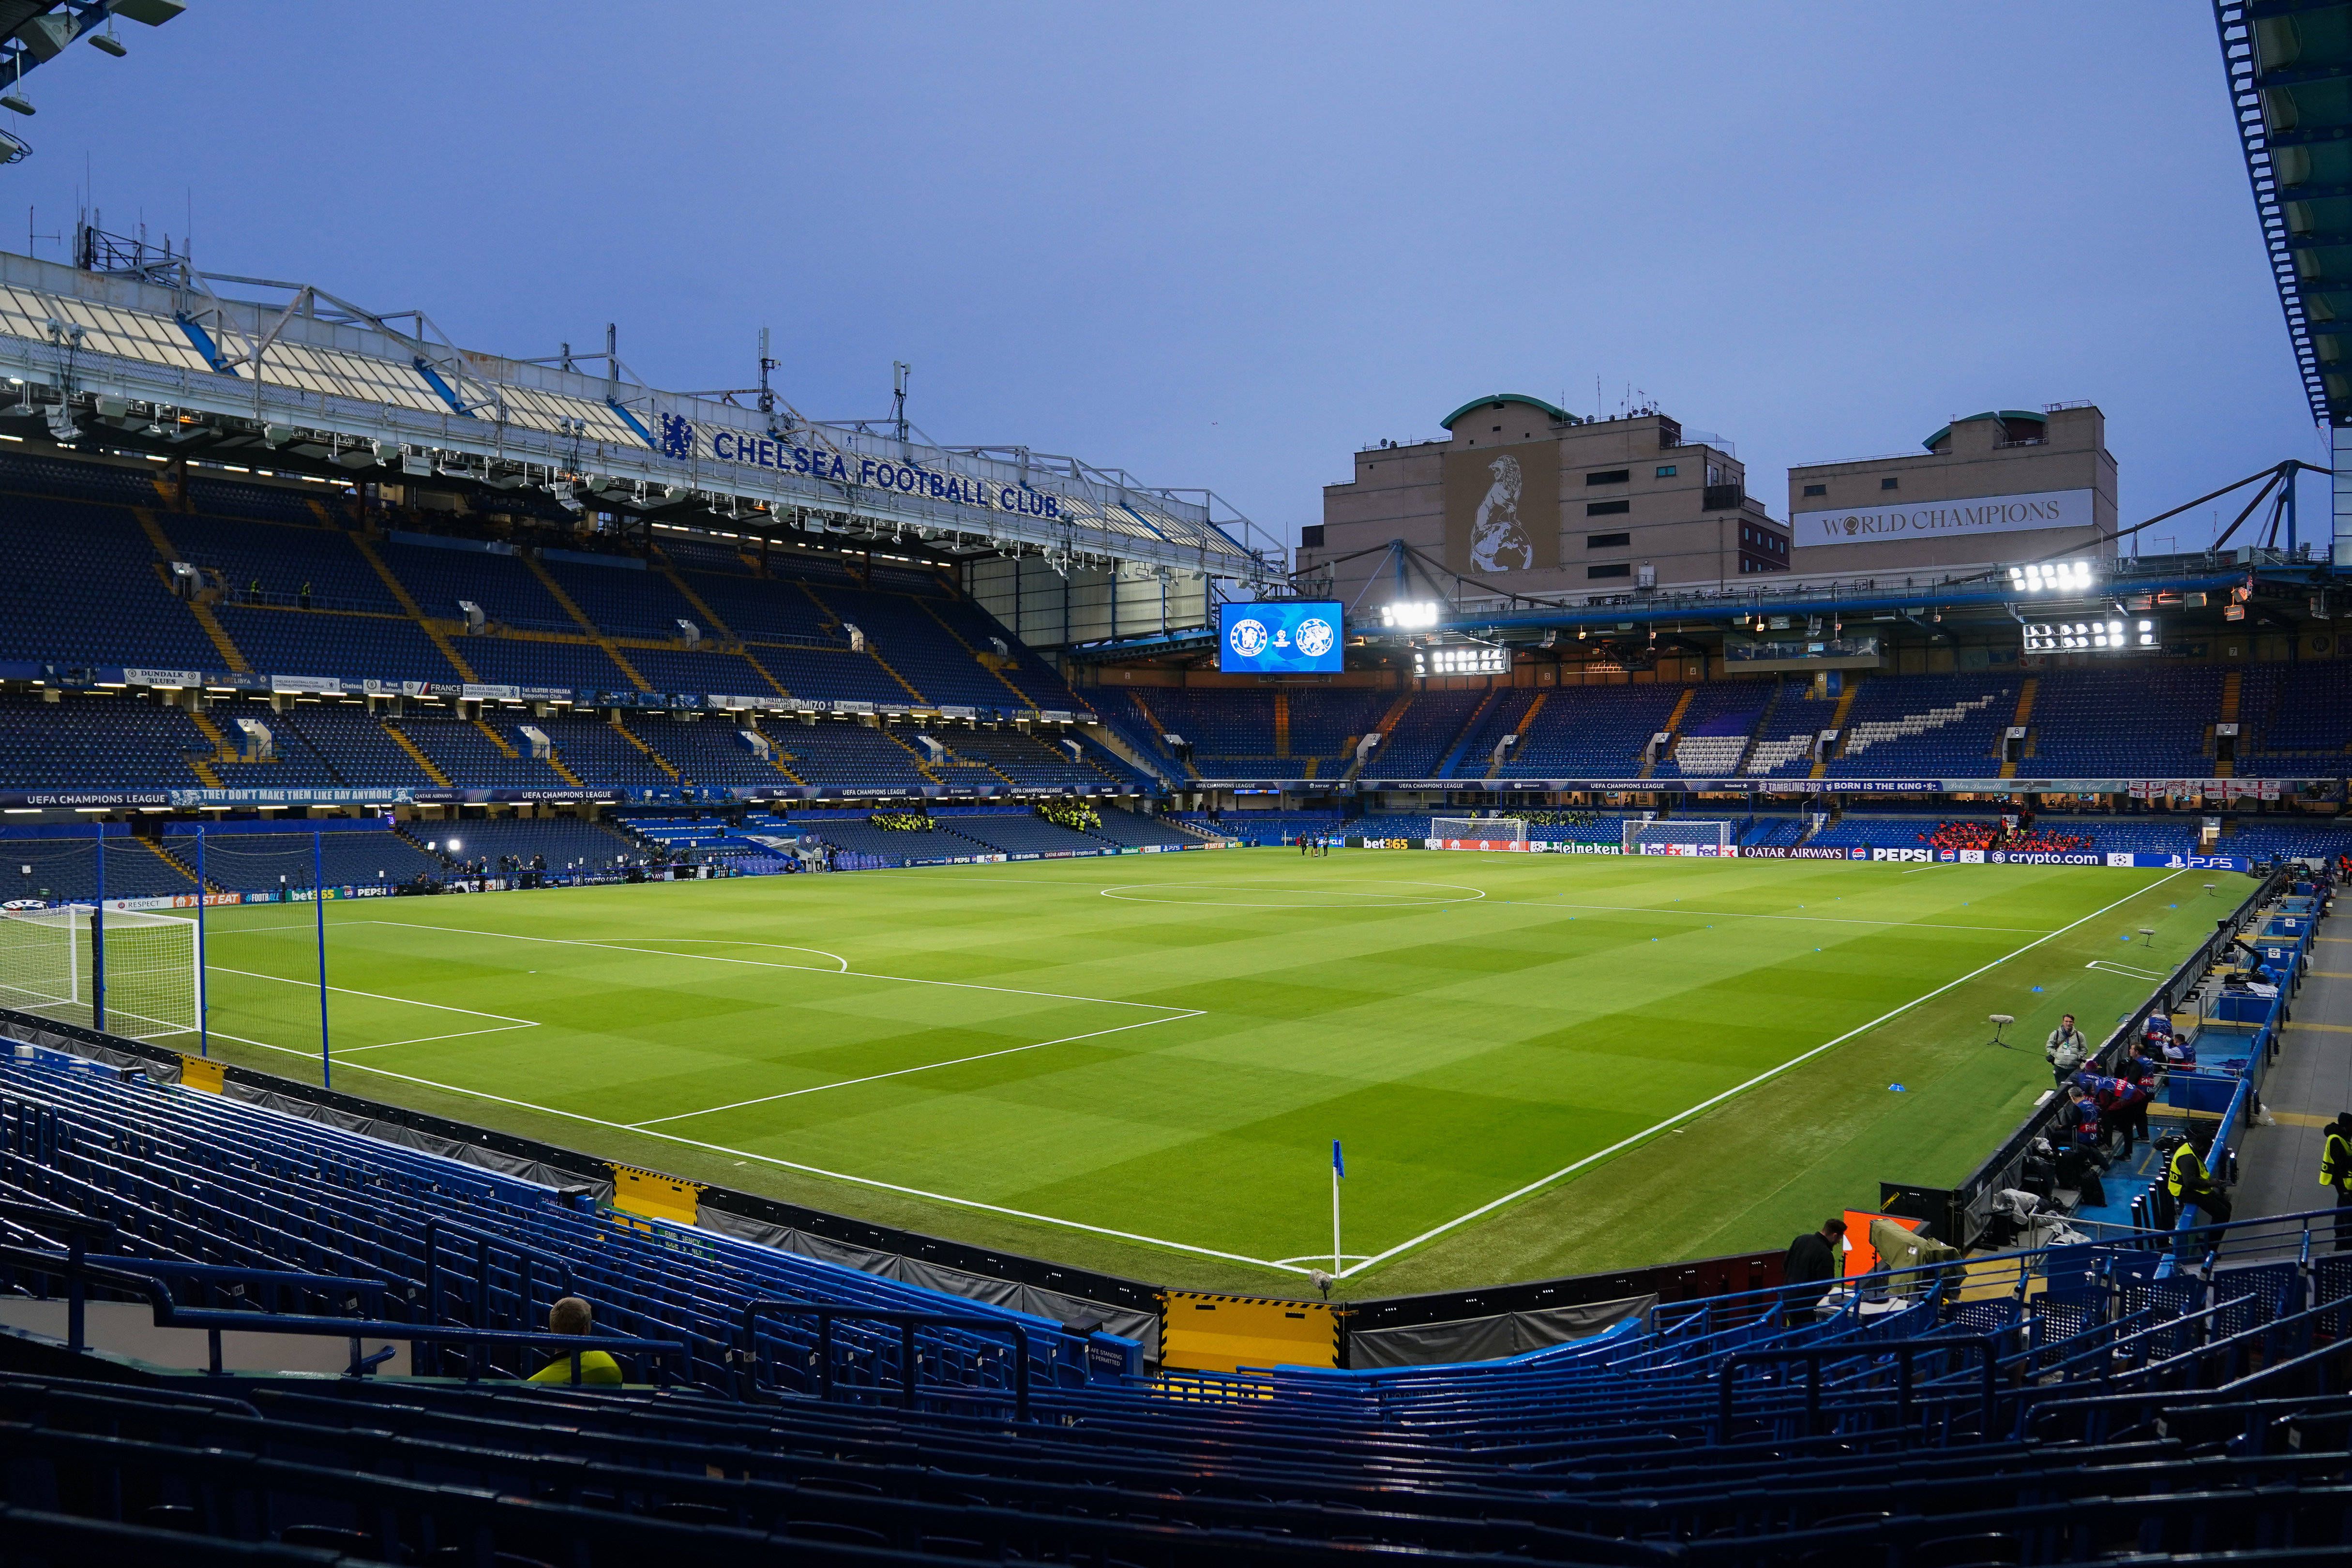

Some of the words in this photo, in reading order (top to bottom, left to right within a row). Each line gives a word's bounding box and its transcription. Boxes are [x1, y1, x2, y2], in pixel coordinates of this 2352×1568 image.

[714, 432, 846, 481] CHELSEA
[861, 459, 989, 506] FOOTBALL
[1001, 487, 1058, 517] CLUB
[1822, 513, 1906, 536] WORLD
[1912, 500, 2060, 529] CHAMPIONS
[800, 700, 826, 710] MIZO
[1768, 783, 1805, 792] TAMBLING
[1948, 782, 1969, 790] Peter
[28, 796, 57, 804] UEFA
[60, 795, 123, 804] CHAMPIONS
[127, 795, 165, 803] LEAGUE
[202, 790, 226, 800] THEY
[228, 789, 256, 800] DON'T
[259, 790, 285, 800] MAKE
[287, 790, 312, 800] THEM
[314, 790, 332, 799] LIKE
[334, 790, 351, 799] RAY
[352, 790, 392, 799] ANYMORE
[1363, 838, 1408, 849] bet365
[1554, 842, 1619, 855] Heineken
[1645, 844, 1682, 856] FedEx
[1697, 844, 1735, 858] FedEx
[1745, 847, 1785, 858] QATAR
[1791, 847, 1842, 859] AIRWAYS
[1873, 848, 1932, 862] PEPSI
[2010, 851, 2098, 865] crypto.com
[2190, 858, 2233, 869] PS5
[358, 887, 386, 896] PEPSI
[470, 881, 494, 891] FeEx
[189, 895, 216, 906] JUST
[217, 893, 238, 904] EAT
[245, 892, 280, 902] #FOOTBALL
[292, 890, 334, 901] bet365
[128, 900, 160, 908] RESPECT
[1100, 1348, 1122, 1360] STANDING
[1096, 1355, 1120, 1366] PERMITTED
